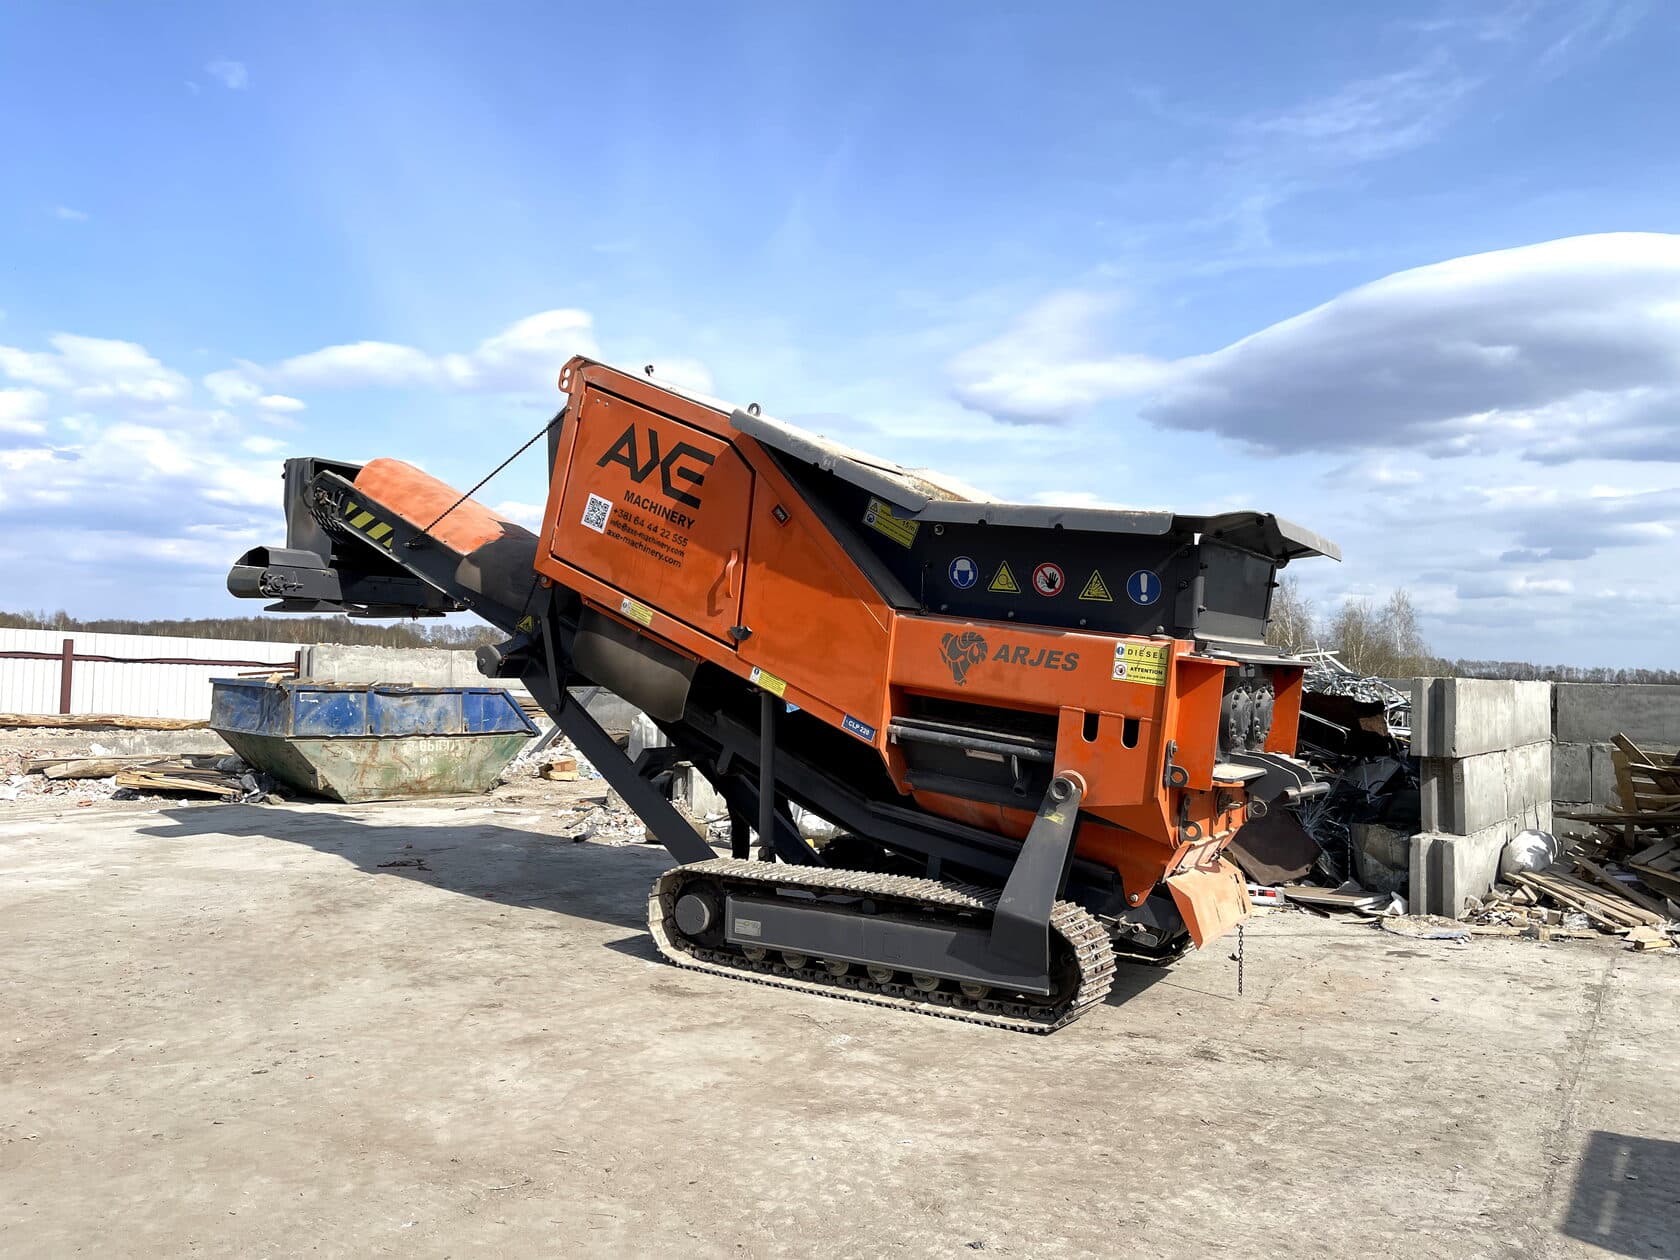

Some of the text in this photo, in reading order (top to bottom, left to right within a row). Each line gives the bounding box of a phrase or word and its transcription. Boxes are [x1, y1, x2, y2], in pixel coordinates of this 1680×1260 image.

[596, 422, 716, 510] AXE
[624, 490, 696, 530] MACHINERY
[613, 508, 689, 547] +381 64 44 22 555
[606, 529, 681, 567] axe-machinery.com
[992, 644, 1079, 671] ARJES
[1127, 648, 1165, 660] DIESEL
[1130, 666, 1163, 675] ATTENTION
[848, 720, 860, 730] CLP
